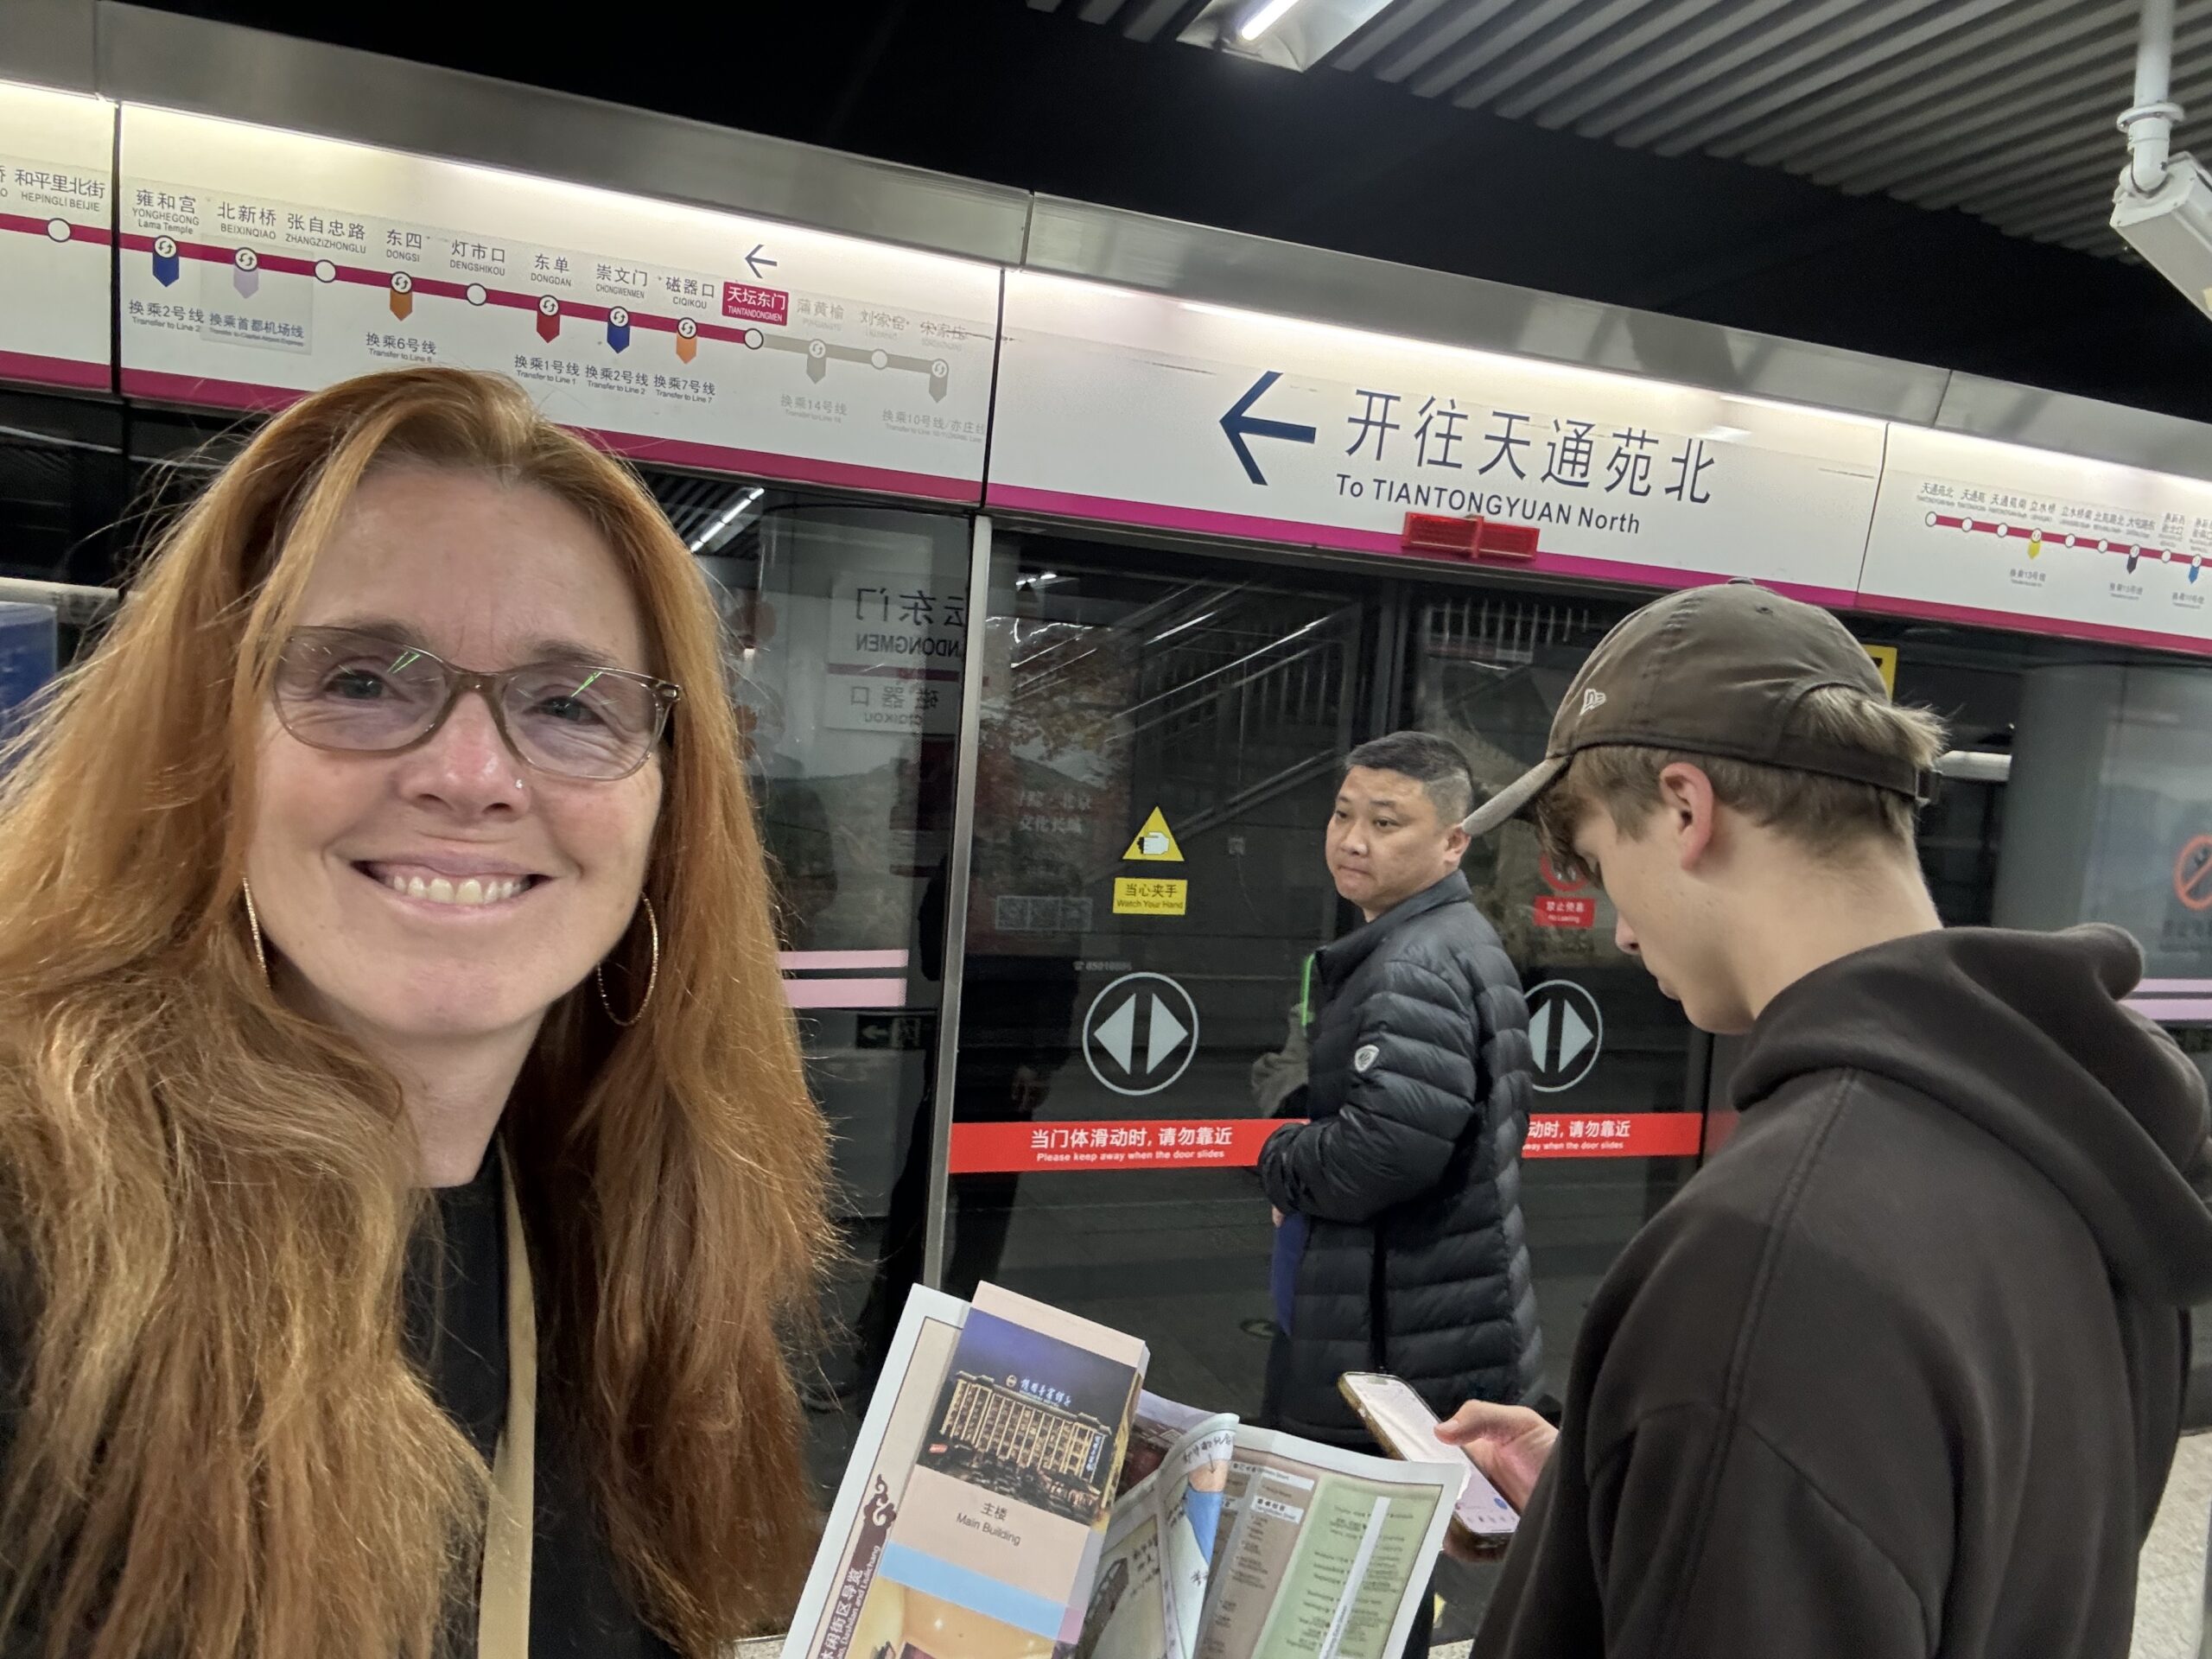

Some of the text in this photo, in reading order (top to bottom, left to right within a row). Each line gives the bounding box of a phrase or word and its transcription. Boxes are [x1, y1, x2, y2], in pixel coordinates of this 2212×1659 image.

[15, 169, 105, 199] 和平里北街
[22, 192, 67, 207] HEPINGLI
[69, 199, 100, 212] BEIJIE
[137, 189, 196, 214] 雍和宫
[132, 208, 200, 226] YONGHEGONG
[218, 201, 276, 226] 北新桥
[138, 219, 194, 236] Lama Temple
[221, 224, 276, 239] BEIXINQIAO
[288, 213, 365, 241] 张自忠路
[285, 232, 366, 254] ZHANGZIZHONGLU
[386, 229, 423, 250] 东四
[386, 249, 420, 262] DONGSI
[452, 239, 505, 264] 灯市口
[450, 259, 505, 276] DENGSHIKOU
[534, 254, 570, 273] 东单
[531, 273, 571, 287] DONGDAN
[596, 264, 648, 287] 崇文门
[595, 283, 645, 299] CHONGWENMEN
[665, 276, 715, 298] 磁器口
[672, 296, 707, 309] CIQIKOU
[728, 286, 787, 311] 天坛东门
[130, 300, 204, 323] 换乘2号线
[728, 306, 783, 322] TIANTANDONGMEN
[132, 316, 165, 327] Transfer
[176, 322, 190, 331] Line
[210, 313, 304, 338] 换乘首都机场线
[365, 332, 436, 355] 换乘6号线
[369, 347, 398, 361] Transfer
[401, 353, 408, 361] to
[410, 353, 425, 363] Line
[514, 353, 581, 378] 换乘1号线
[517, 370, 576, 385] Transfer to Line 1
[585, 364, 649, 388] 换乘2号线
[653, 373, 716, 397] 换乘7号线
[587, 380, 645, 396] Transfer to Line 2
[656, 389, 683, 402] Transfer
[684, 393, 691, 402] to
[692, 394, 706, 404] Line
[781, 394, 848, 416] 换乘14号线
[1345, 389, 1715, 505] 开往天通苑北
[1336, 474, 1641, 535] To TIANTONGYUAN North
[1125, 883, 1177, 898] 当心夹手
[1037, 1149, 1225, 1162] Please keep away when the door slides
[980, 1503, 1007, 1521] 主楼
[956, 1512, 1021, 1547] Main Building
